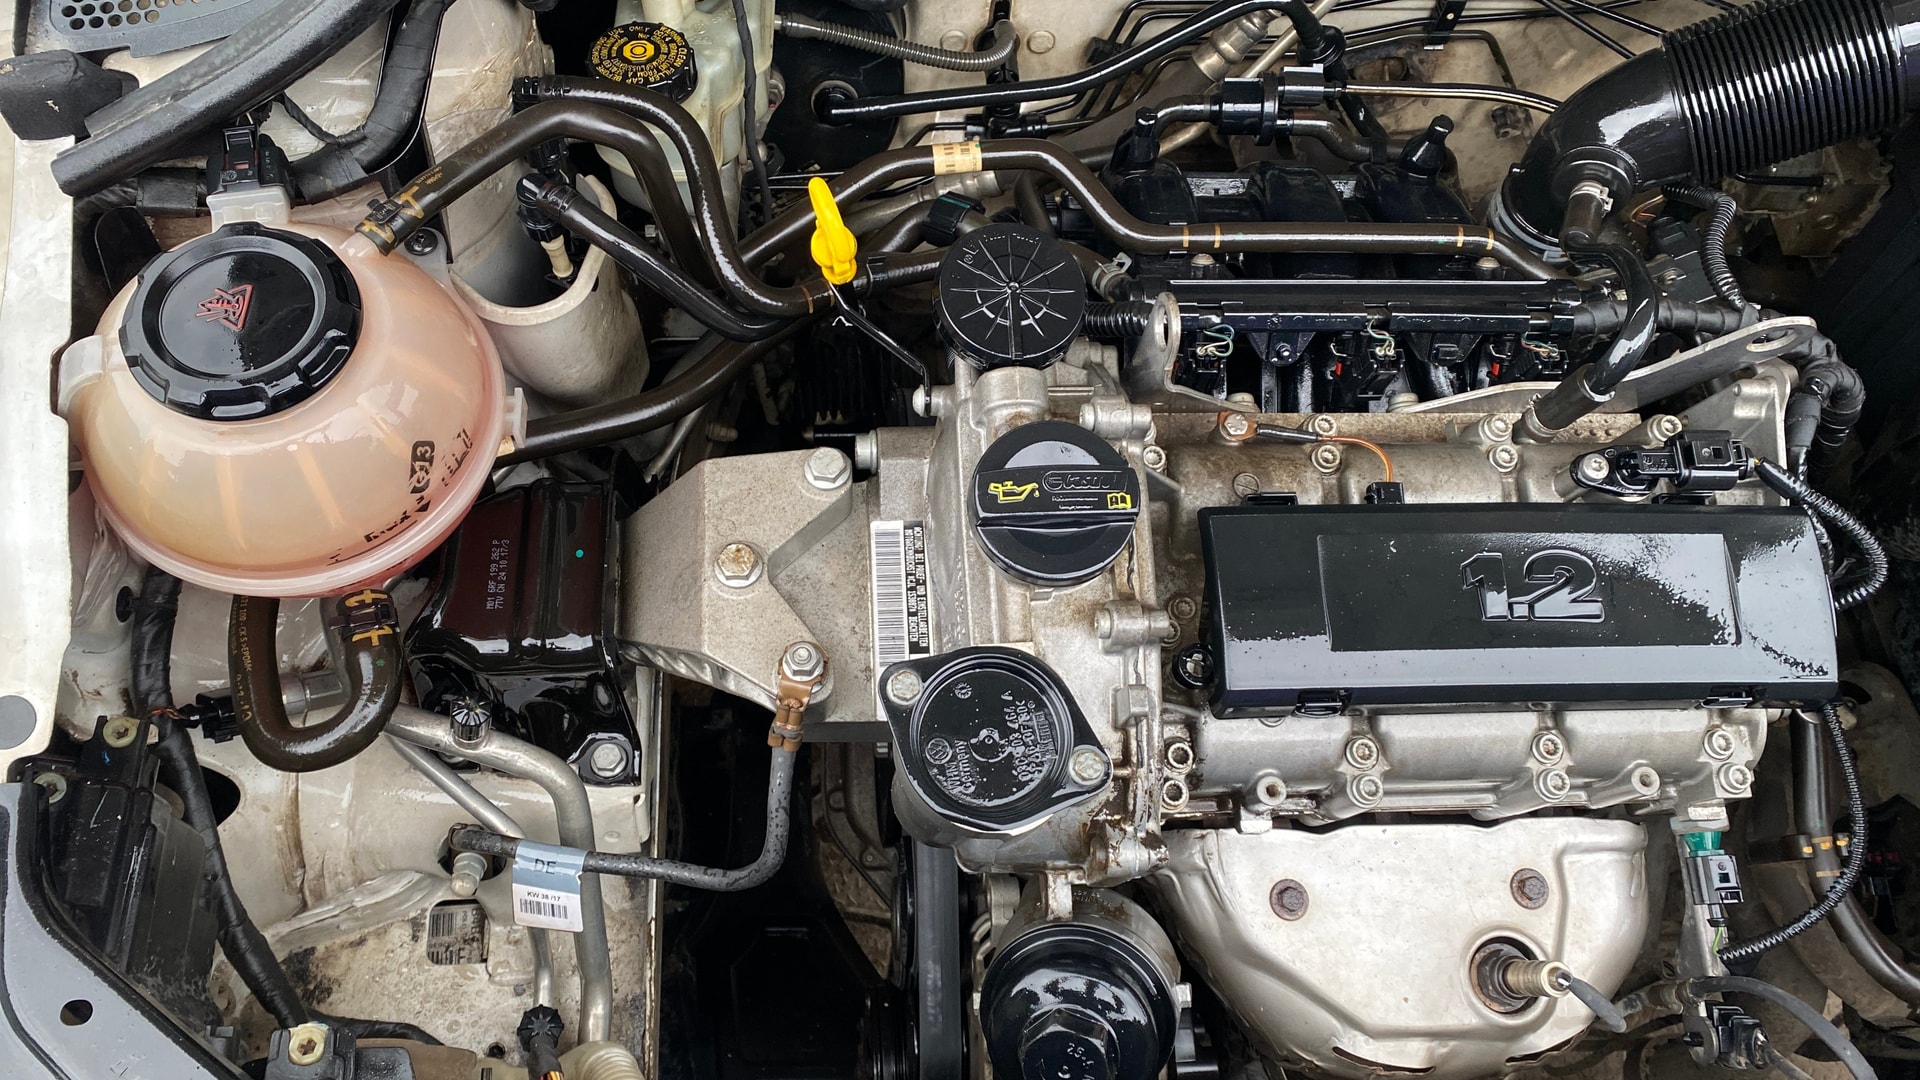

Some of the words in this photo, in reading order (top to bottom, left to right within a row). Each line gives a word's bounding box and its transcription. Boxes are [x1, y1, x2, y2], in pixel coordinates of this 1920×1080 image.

[595, 65, 623, 82] BEFORE
[637, 68, 660, 78] FROM
[648, 68, 675, 83] FILLER
[491, 547, 500, 560] 262
[489, 563, 498, 576] 199
[487, 579, 497, 593] 6RF
[497, 583, 506, 593] CN
[1460, 548, 1605, 623] 1.2
[1000, 690, 1013, 701] A
[954, 740, 975, 794] Germany
[533, 858, 557, 875] DE
[526, 890, 540, 898] KW
